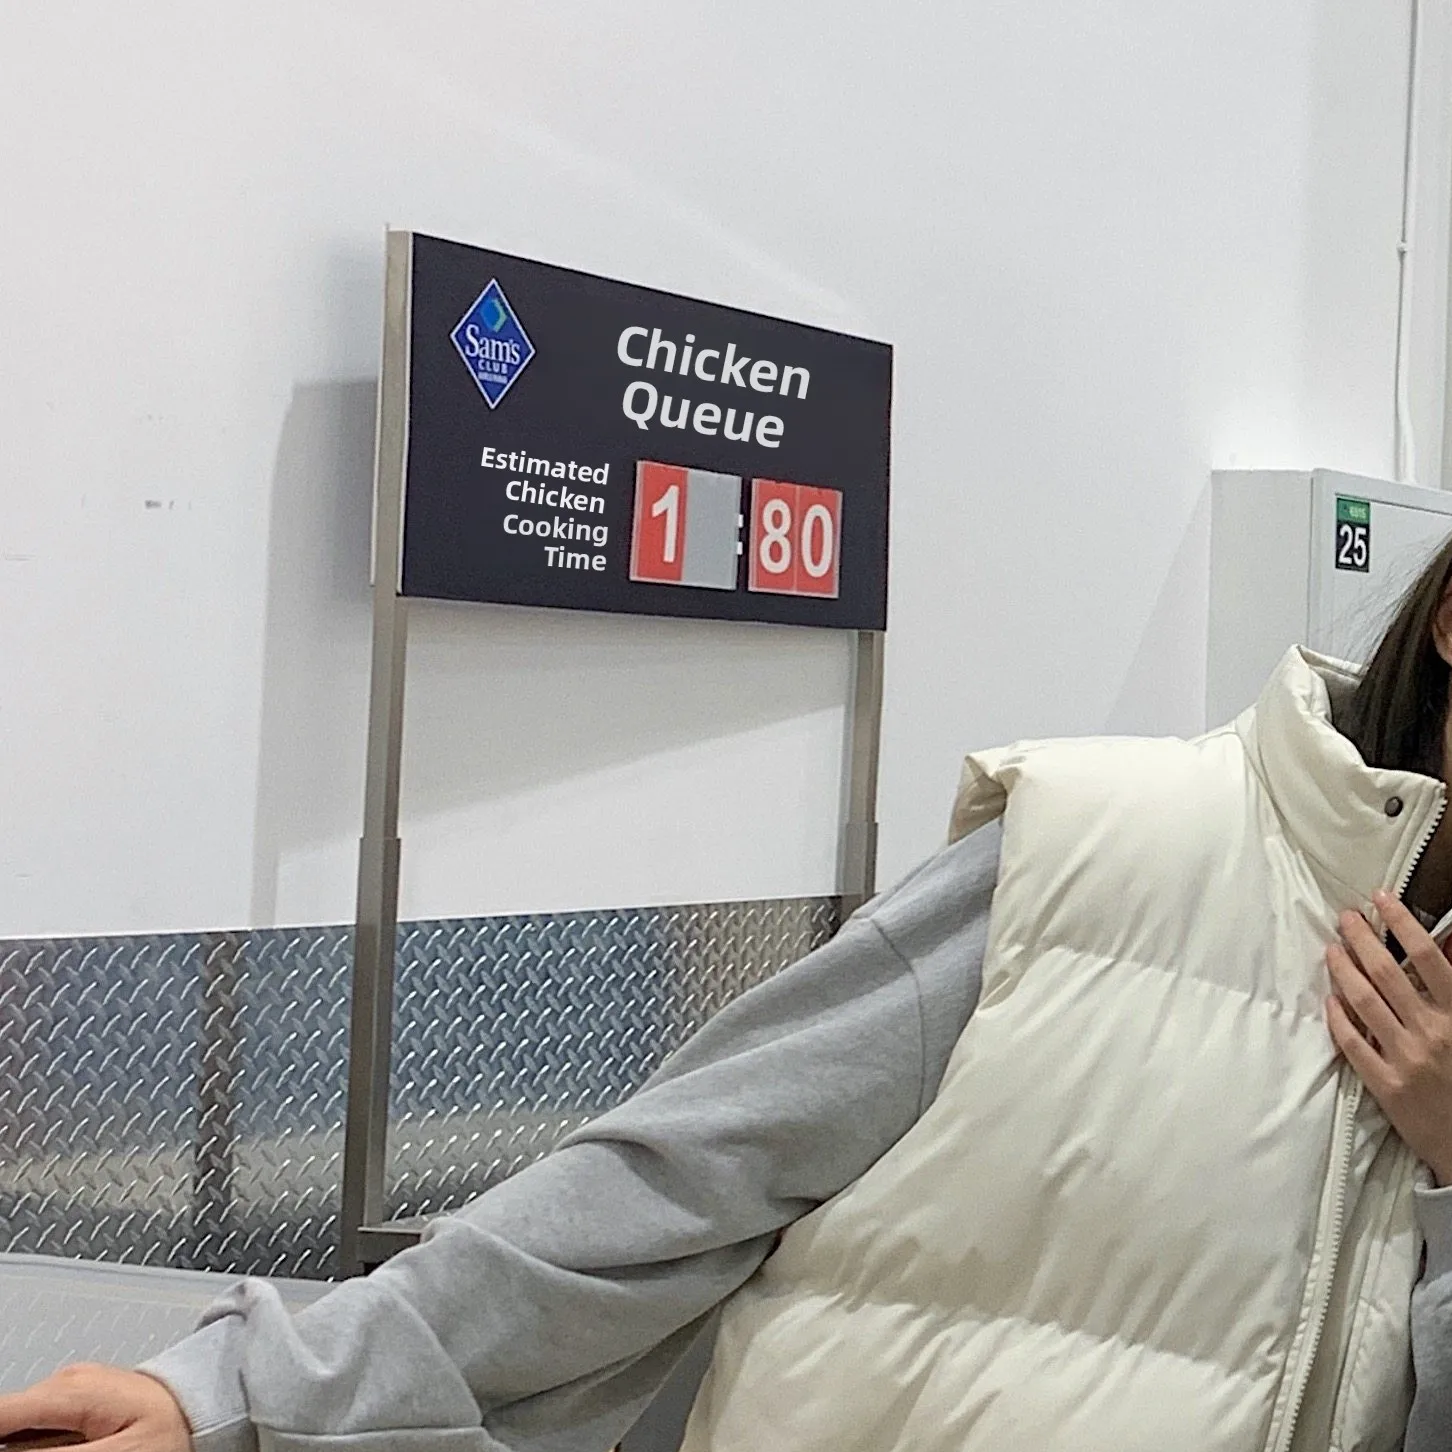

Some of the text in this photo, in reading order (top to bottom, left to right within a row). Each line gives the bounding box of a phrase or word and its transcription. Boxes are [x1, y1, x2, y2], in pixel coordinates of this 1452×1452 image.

[464, 323, 521, 365] Sam's
[617, 325, 811, 400] Chicken
[477, 359, 509, 375] CLUB
[622, 381, 785, 448] Queue
[480, 446, 610, 486] Estimated
[505, 480, 605, 514] Chicken
[503, 513, 609, 547] Cooking
[1338, 523, 1367, 567] 25
[544, 545, 607, 571] Time
